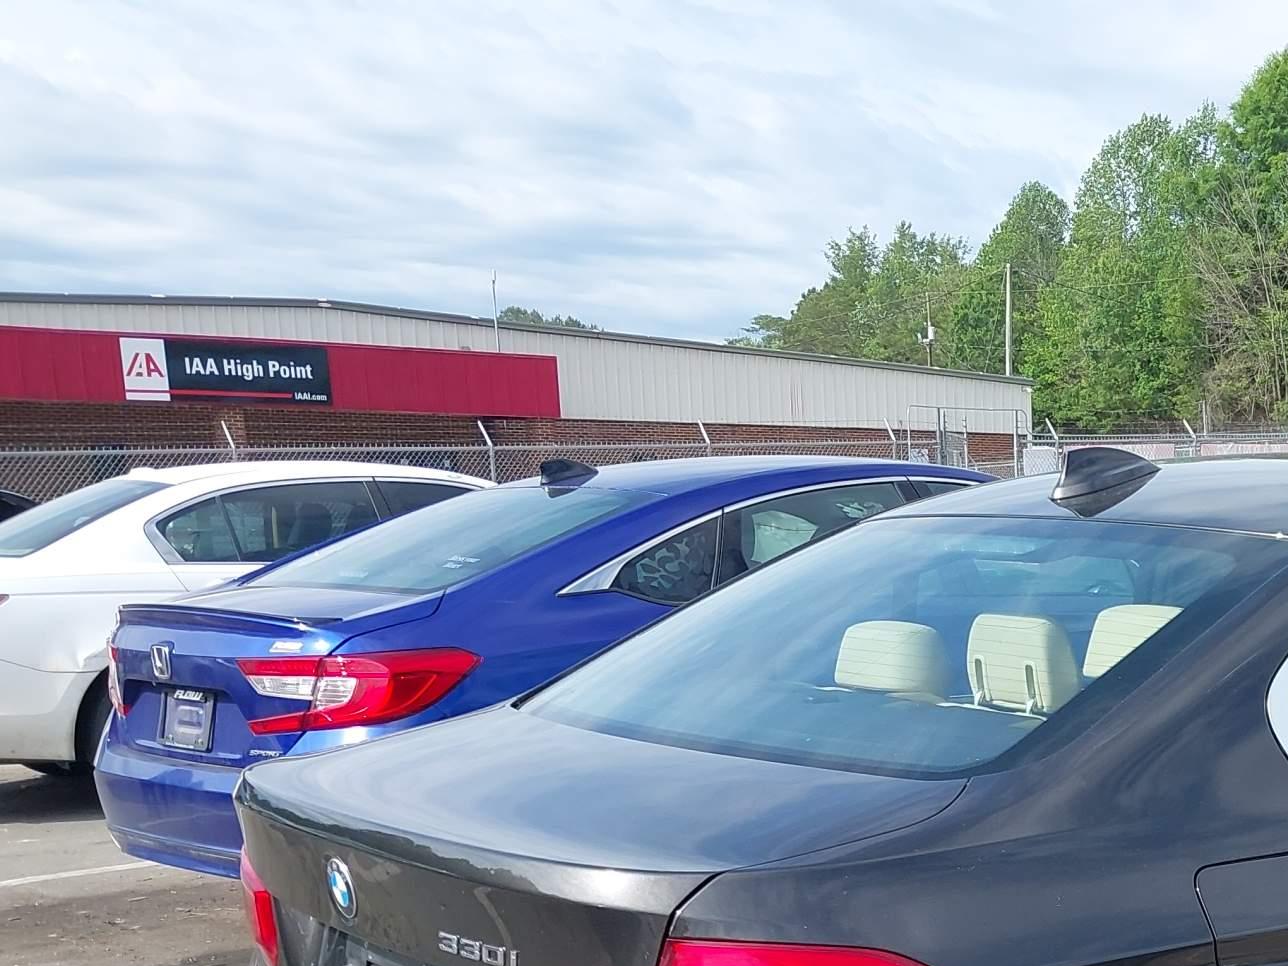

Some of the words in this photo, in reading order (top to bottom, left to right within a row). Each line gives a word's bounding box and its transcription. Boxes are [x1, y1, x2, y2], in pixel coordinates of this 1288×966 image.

[184, 356, 219, 375] IAA
[222, 358, 263, 381] High
[267, 360, 313, 380] Point
[294, 391, 328, 401] IAAI.com
